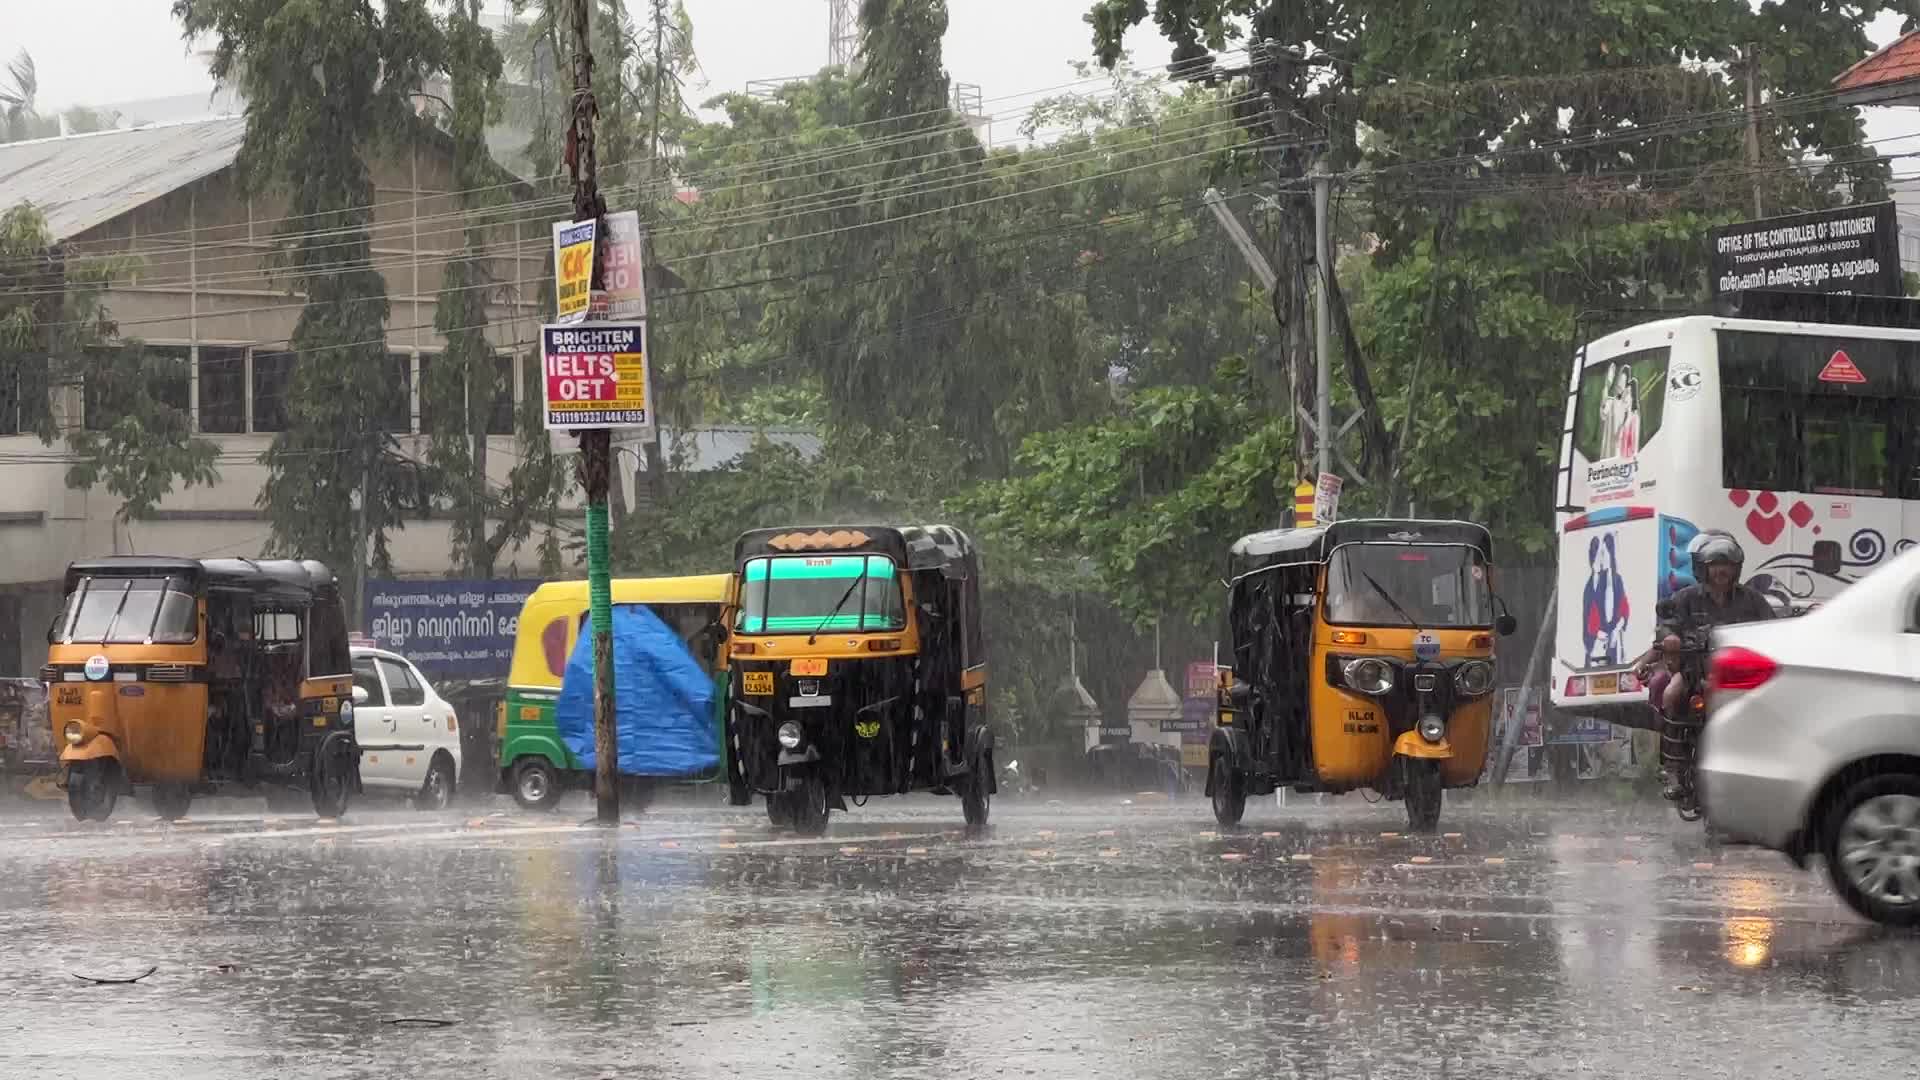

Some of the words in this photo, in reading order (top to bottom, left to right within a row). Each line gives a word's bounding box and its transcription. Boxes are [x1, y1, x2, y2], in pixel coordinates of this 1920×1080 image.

[1717, 235, 1743, 254] OFFICE
[1743, 233, 1753, 250] OF
[1754, 231, 1769, 248] THE
[1769, 224, 1817, 246] CONTROLLER
[1818, 222, 1828, 239] OF
[1829, 216, 1877, 238] STATIONERY
[552, 330, 634, 345] BRIGHTEN
[557, 343, 630, 353] ACADEMY
[548, 354, 613, 376] IELTS
[559, 379, 605, 400] OET
